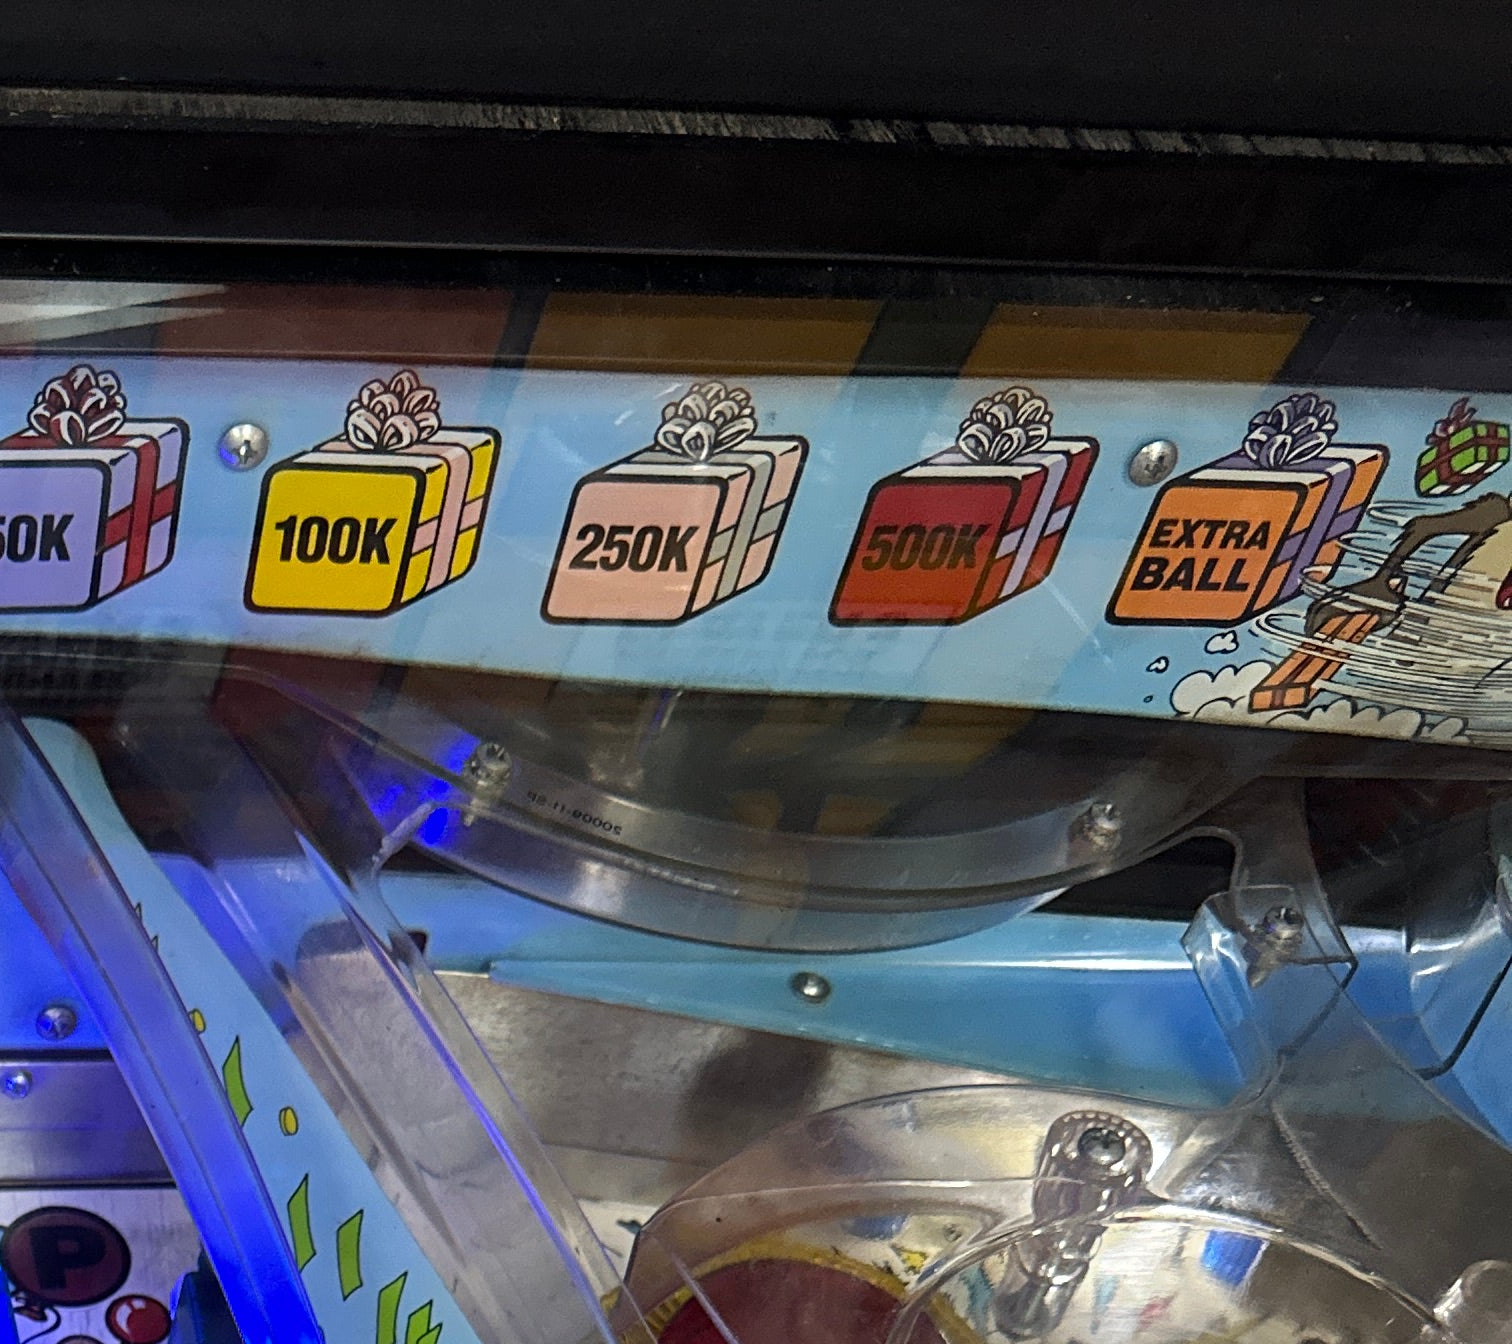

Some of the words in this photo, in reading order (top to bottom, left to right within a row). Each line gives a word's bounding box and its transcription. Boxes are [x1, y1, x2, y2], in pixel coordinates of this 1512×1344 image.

[274, 514, 397, 566] 100K
[568, 525, 699, 572] 250K
[861, 523, 991, 571] 500K
[1149, 518, 1272, 551] EXTRA
[1130, 557, 1251, 592] BALL
[29, 1224, 107, 1290] P
